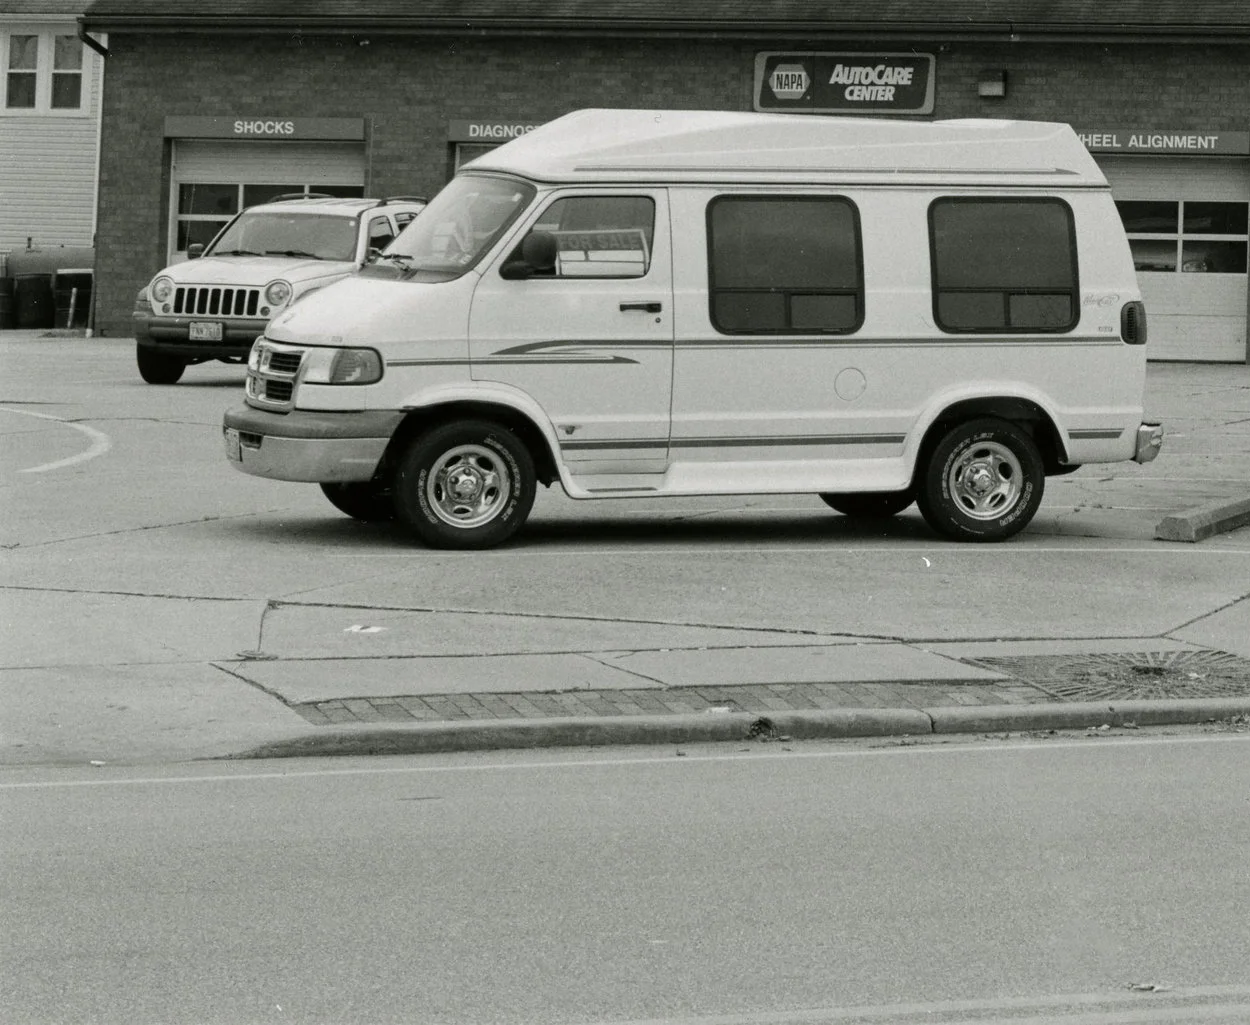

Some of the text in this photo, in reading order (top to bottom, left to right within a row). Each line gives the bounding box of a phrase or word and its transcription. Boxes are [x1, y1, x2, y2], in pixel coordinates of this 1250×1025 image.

[775, 73, 804, 90] NAPA
[844, 85, 895, 101] CENTER
[233, 121, 295, 135] SHOCKS
[1078, 133, 1219, 149] HEEL ALIGNMENT
[597, 233, 641, 250] SALE
